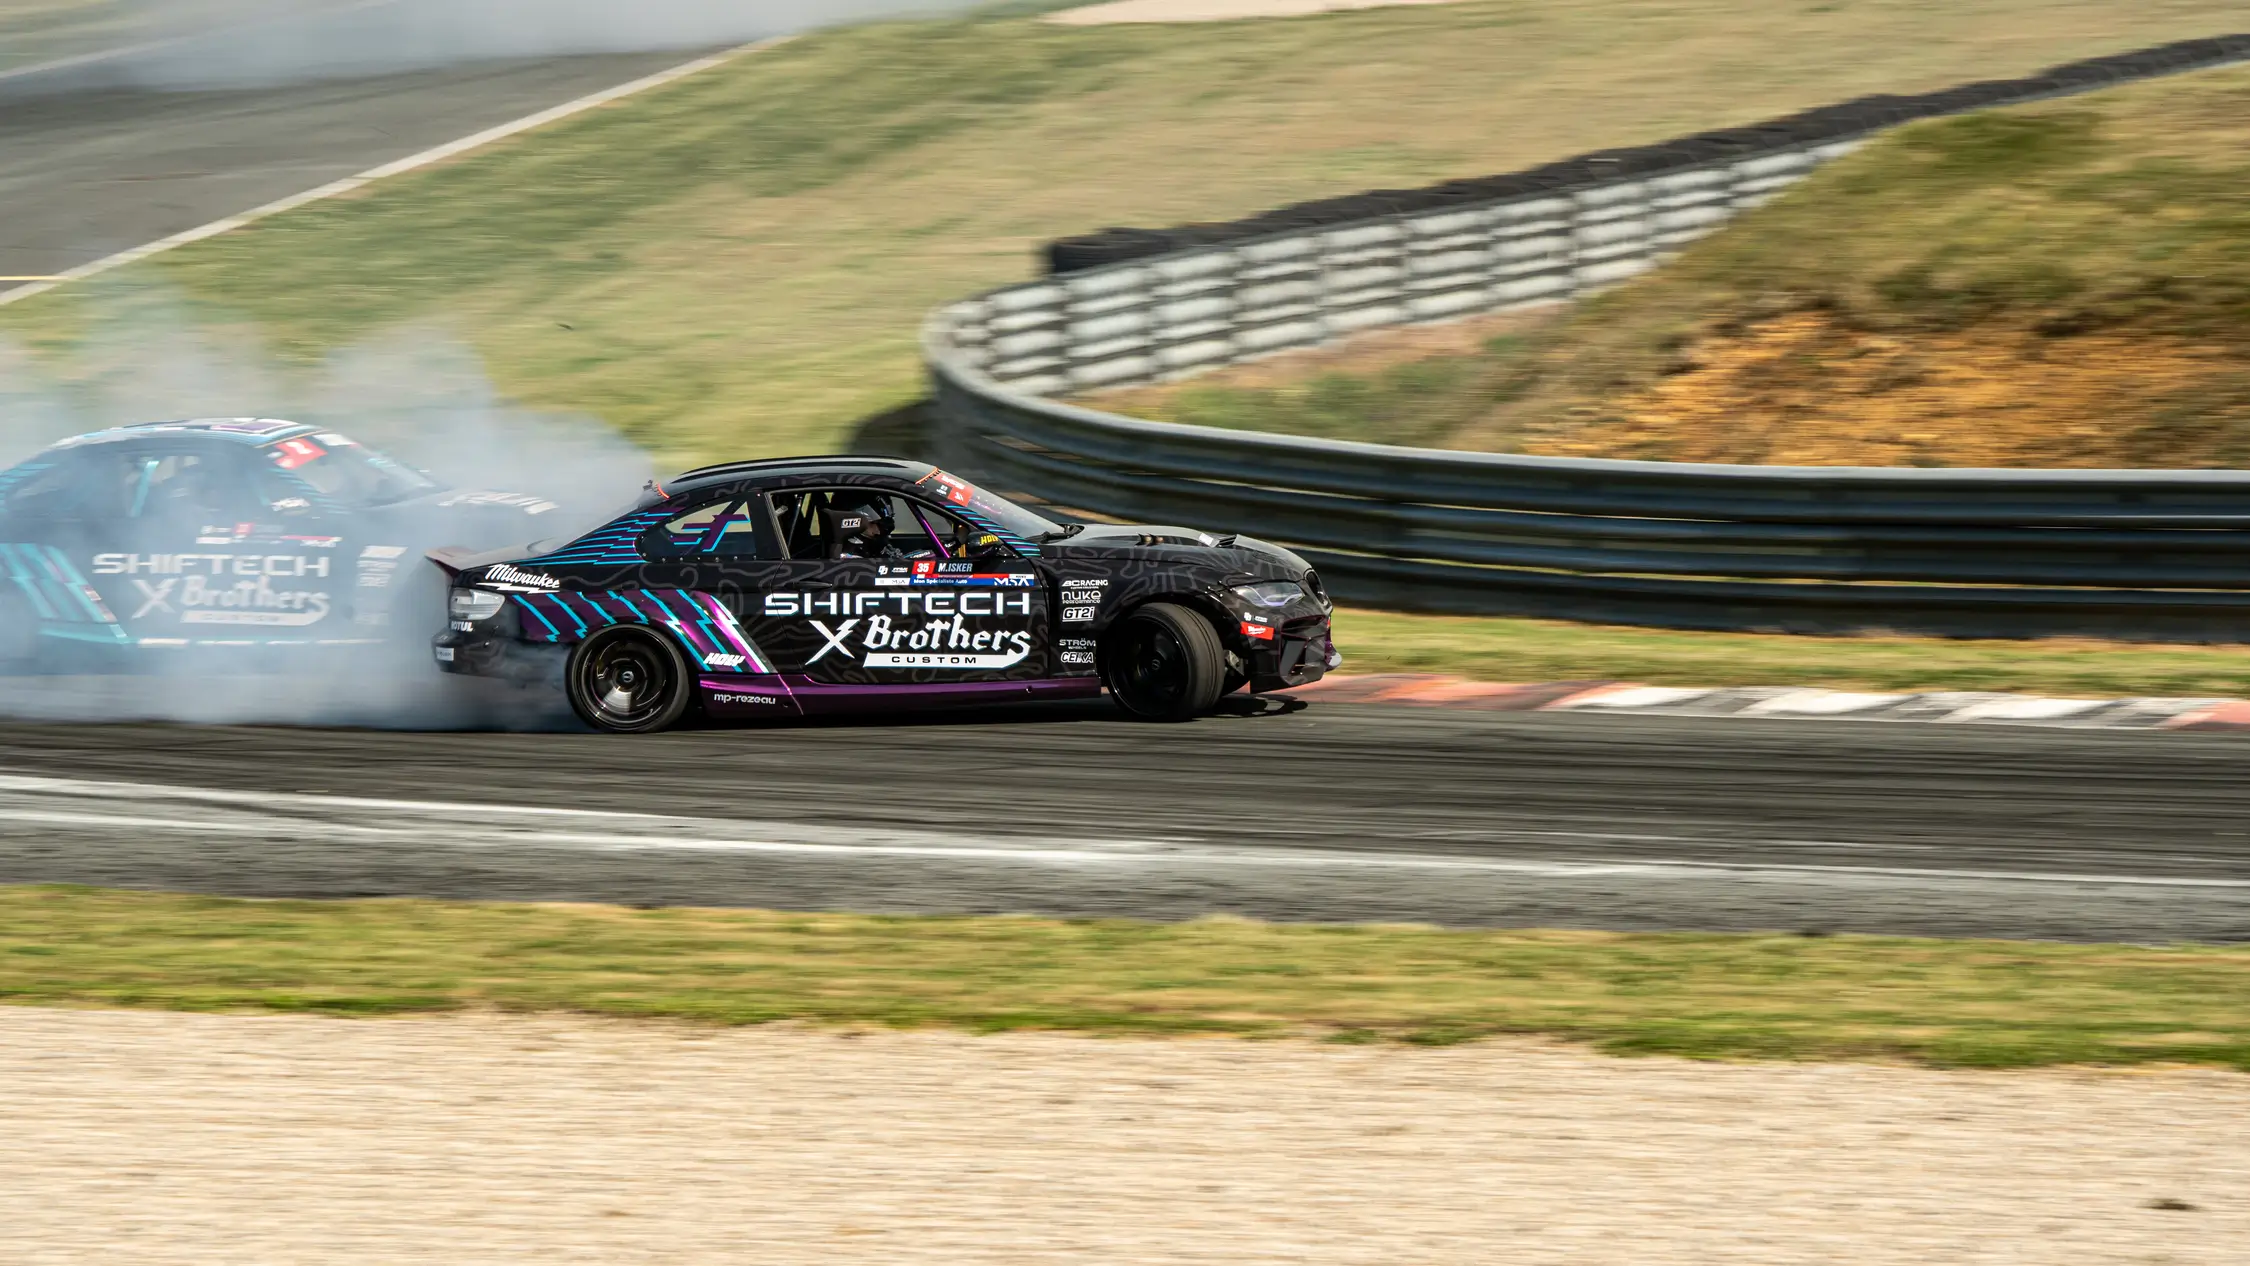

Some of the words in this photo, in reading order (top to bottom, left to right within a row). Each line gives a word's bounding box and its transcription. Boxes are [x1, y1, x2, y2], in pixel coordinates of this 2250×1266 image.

[91, 553, 330, 576] SHIFTECH
[917, 563, 930, 573] 35
[938, 562, 973, 573] M.ISKER
[485, 564, 560, 589] Milwaukee
[132, 579, 180, 619] X
[181, 575, 331, 617] Brothers
[1061, 590, 1102, 600] nuke
[764, 592, 1031, 616] SHIFTECH
[1062, 606, 1095, 620] GT2i
[804, 619, 861, 666] X
[862, 613, 1031, 656] Brothers
[1059, 637, 1096, 647] STRÖM
[890, 656, 978, 664] CUSTOM
